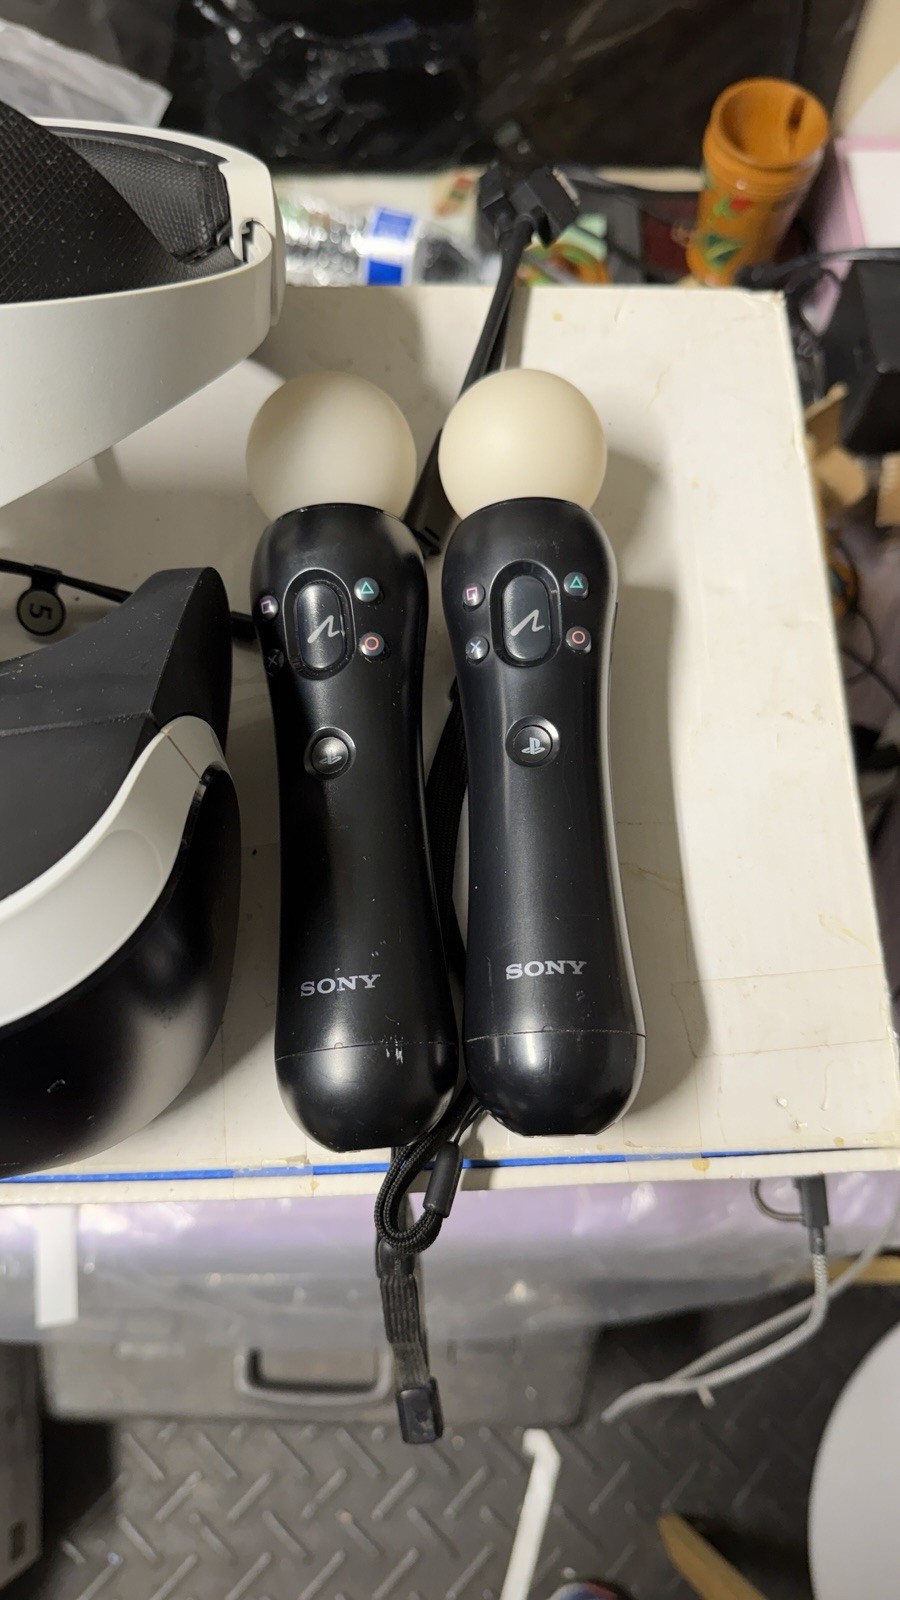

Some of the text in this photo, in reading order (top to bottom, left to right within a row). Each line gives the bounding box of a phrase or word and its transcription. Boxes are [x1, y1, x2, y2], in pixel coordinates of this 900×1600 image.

[29, 603, 53, 620] 5
[505, 959, 588, 981] SONY
[300, 974, 381, 997] SONY
